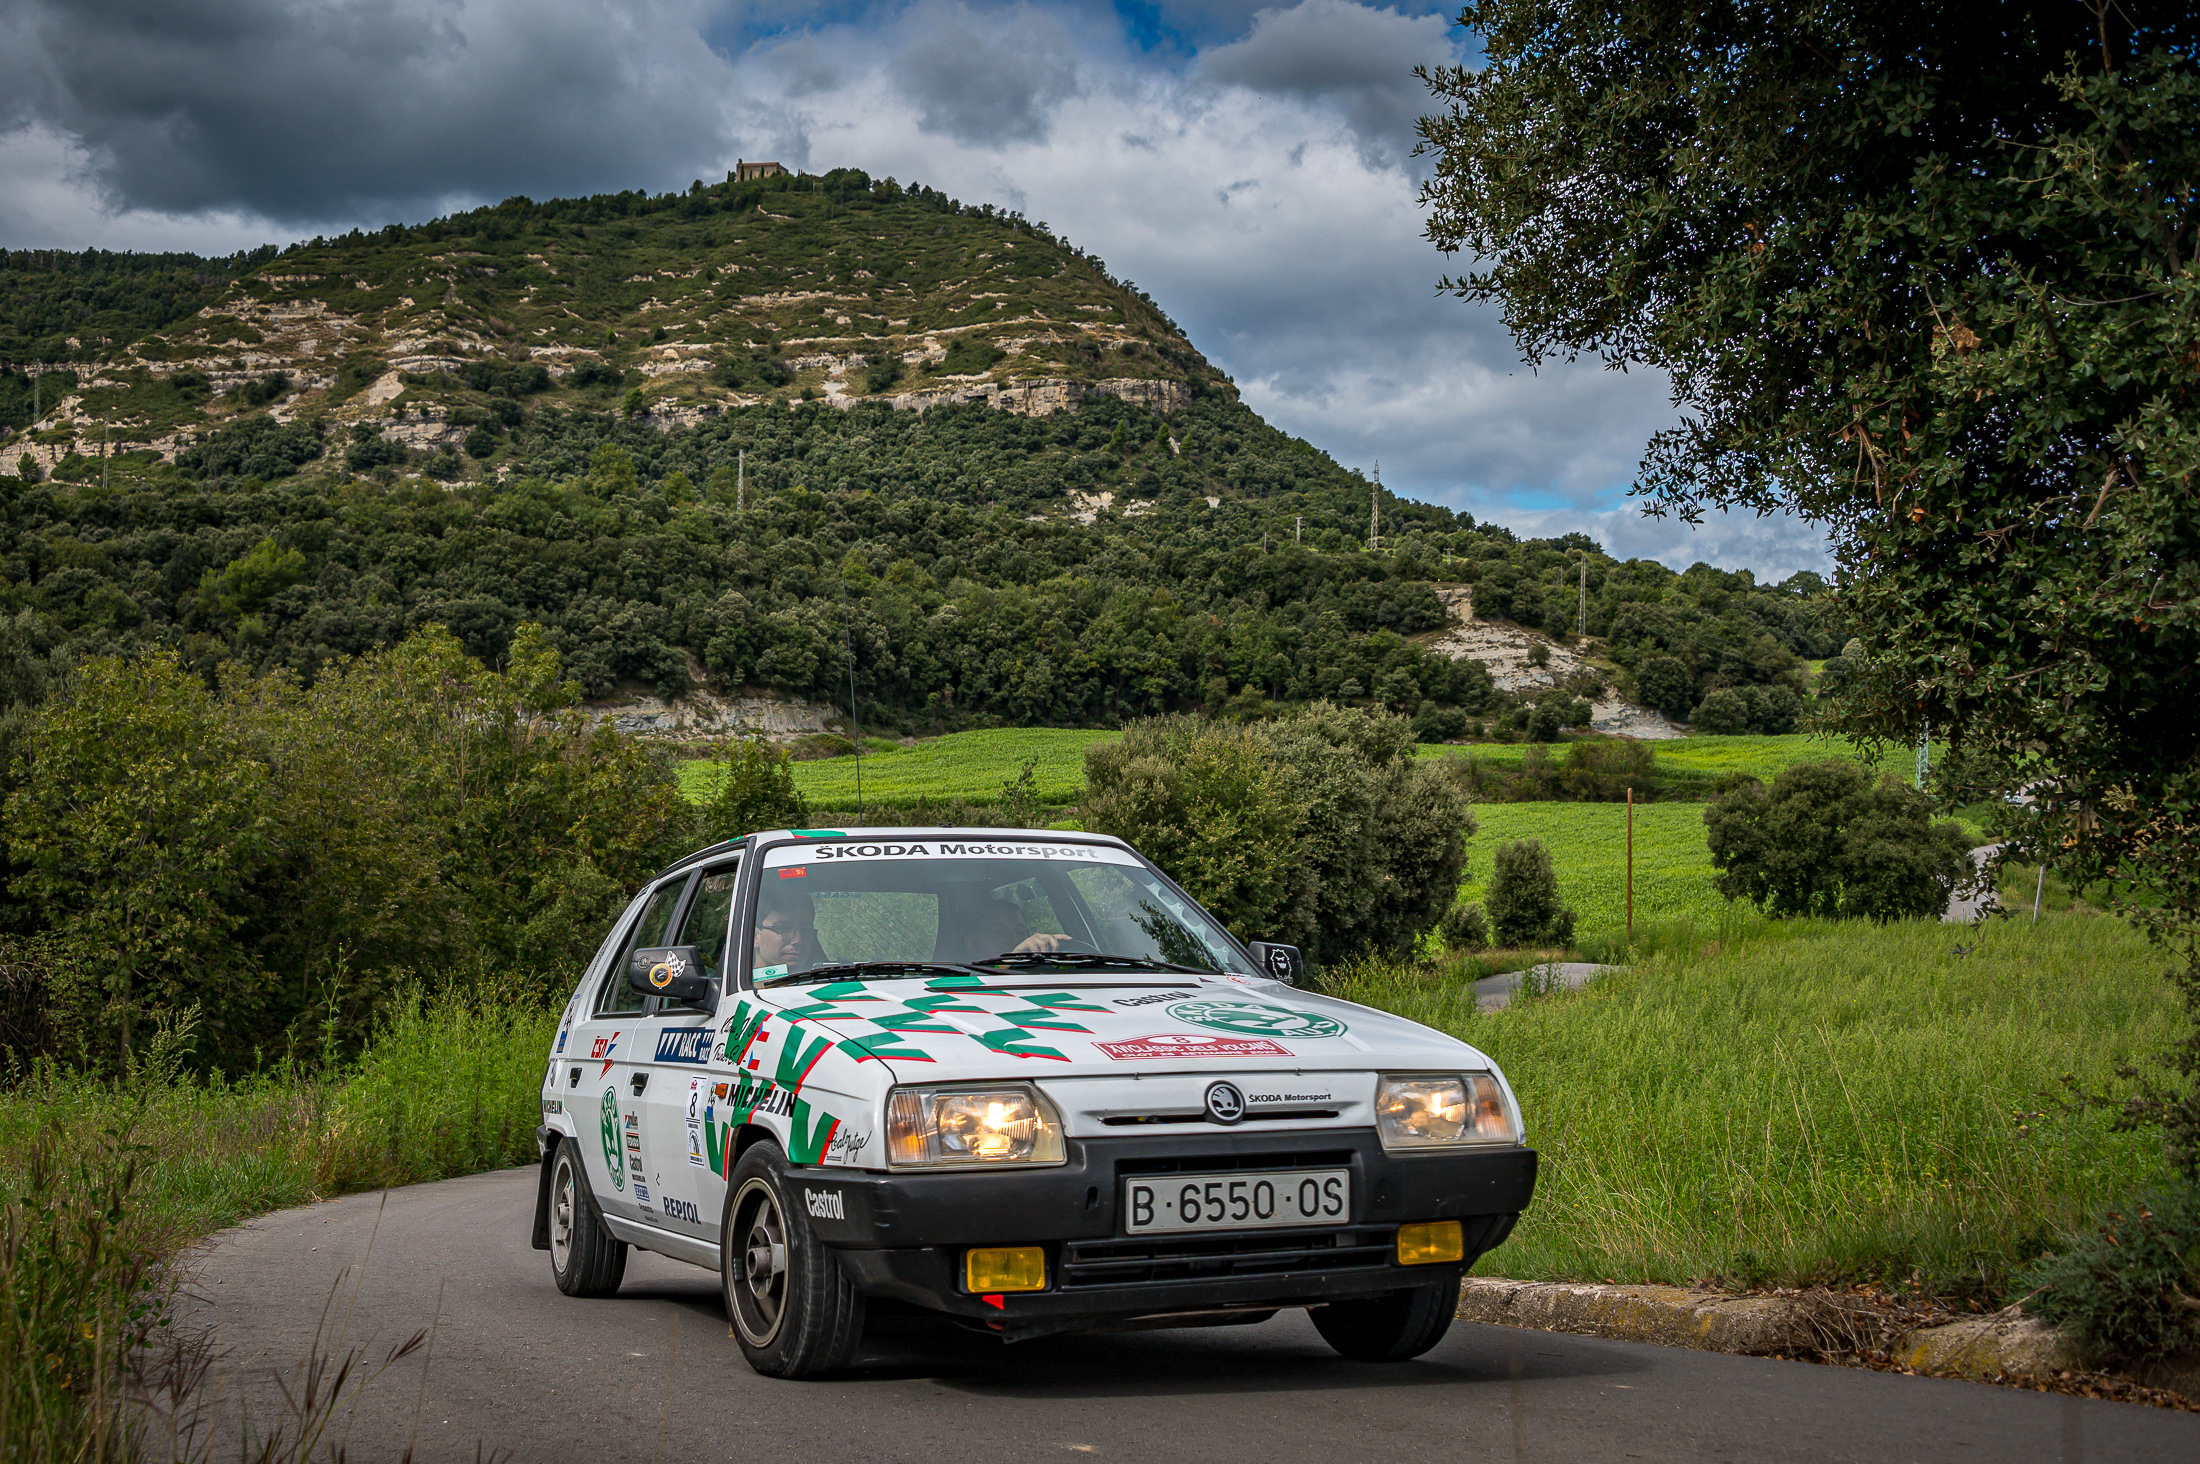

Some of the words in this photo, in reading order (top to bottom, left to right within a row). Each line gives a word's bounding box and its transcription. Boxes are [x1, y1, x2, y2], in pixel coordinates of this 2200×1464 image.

[816, 844, 930, 859] ŠKODA
[940, 844, 1099, 858] Motorsport
[1112, 990, 1198, 1007] Castrol
[678, 1032, 702, 1058] RACC
[1218, 1041, 1276, 1051] VOLCANS
[689, 1092, 698, 1118] 8
[727, 1083, 799, 1118] MICHELIN
[1249, 1093, 1282, 1102] ŠKODA
[1284, 1093, 1332, 1102] Motorsport
[663, 1196, 702, 1226] REPSOL
[805, 1187, 845, 1220] Castrol
